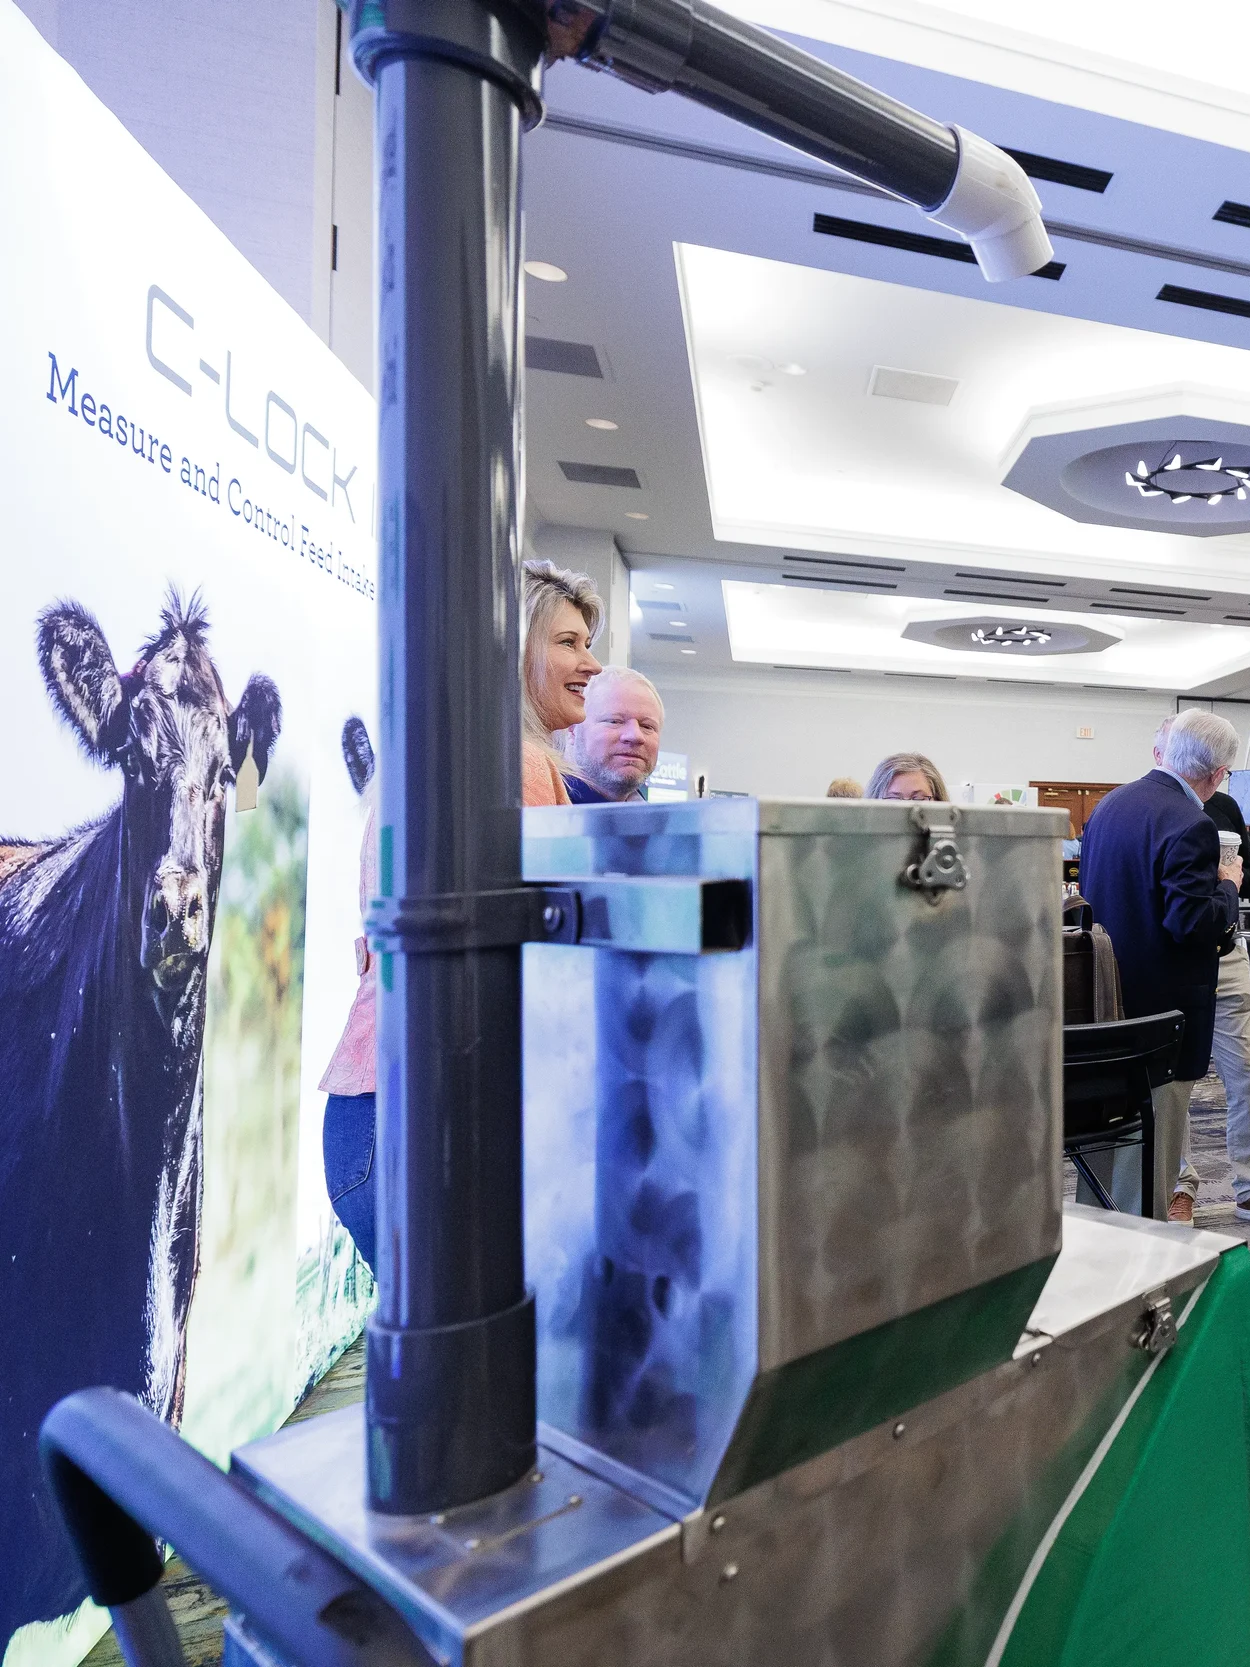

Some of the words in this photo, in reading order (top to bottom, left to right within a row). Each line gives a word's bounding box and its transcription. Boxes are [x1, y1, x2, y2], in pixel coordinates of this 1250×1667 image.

[46, 351, 172, 473] Measure
[180, 456, 220, 504] and
[228, 478, 295, 551] Control
[300, 524, 332, 575] Feed
[337, 550, 374, 601] Intake
[146, 284, 358, 524] C-LOCK
